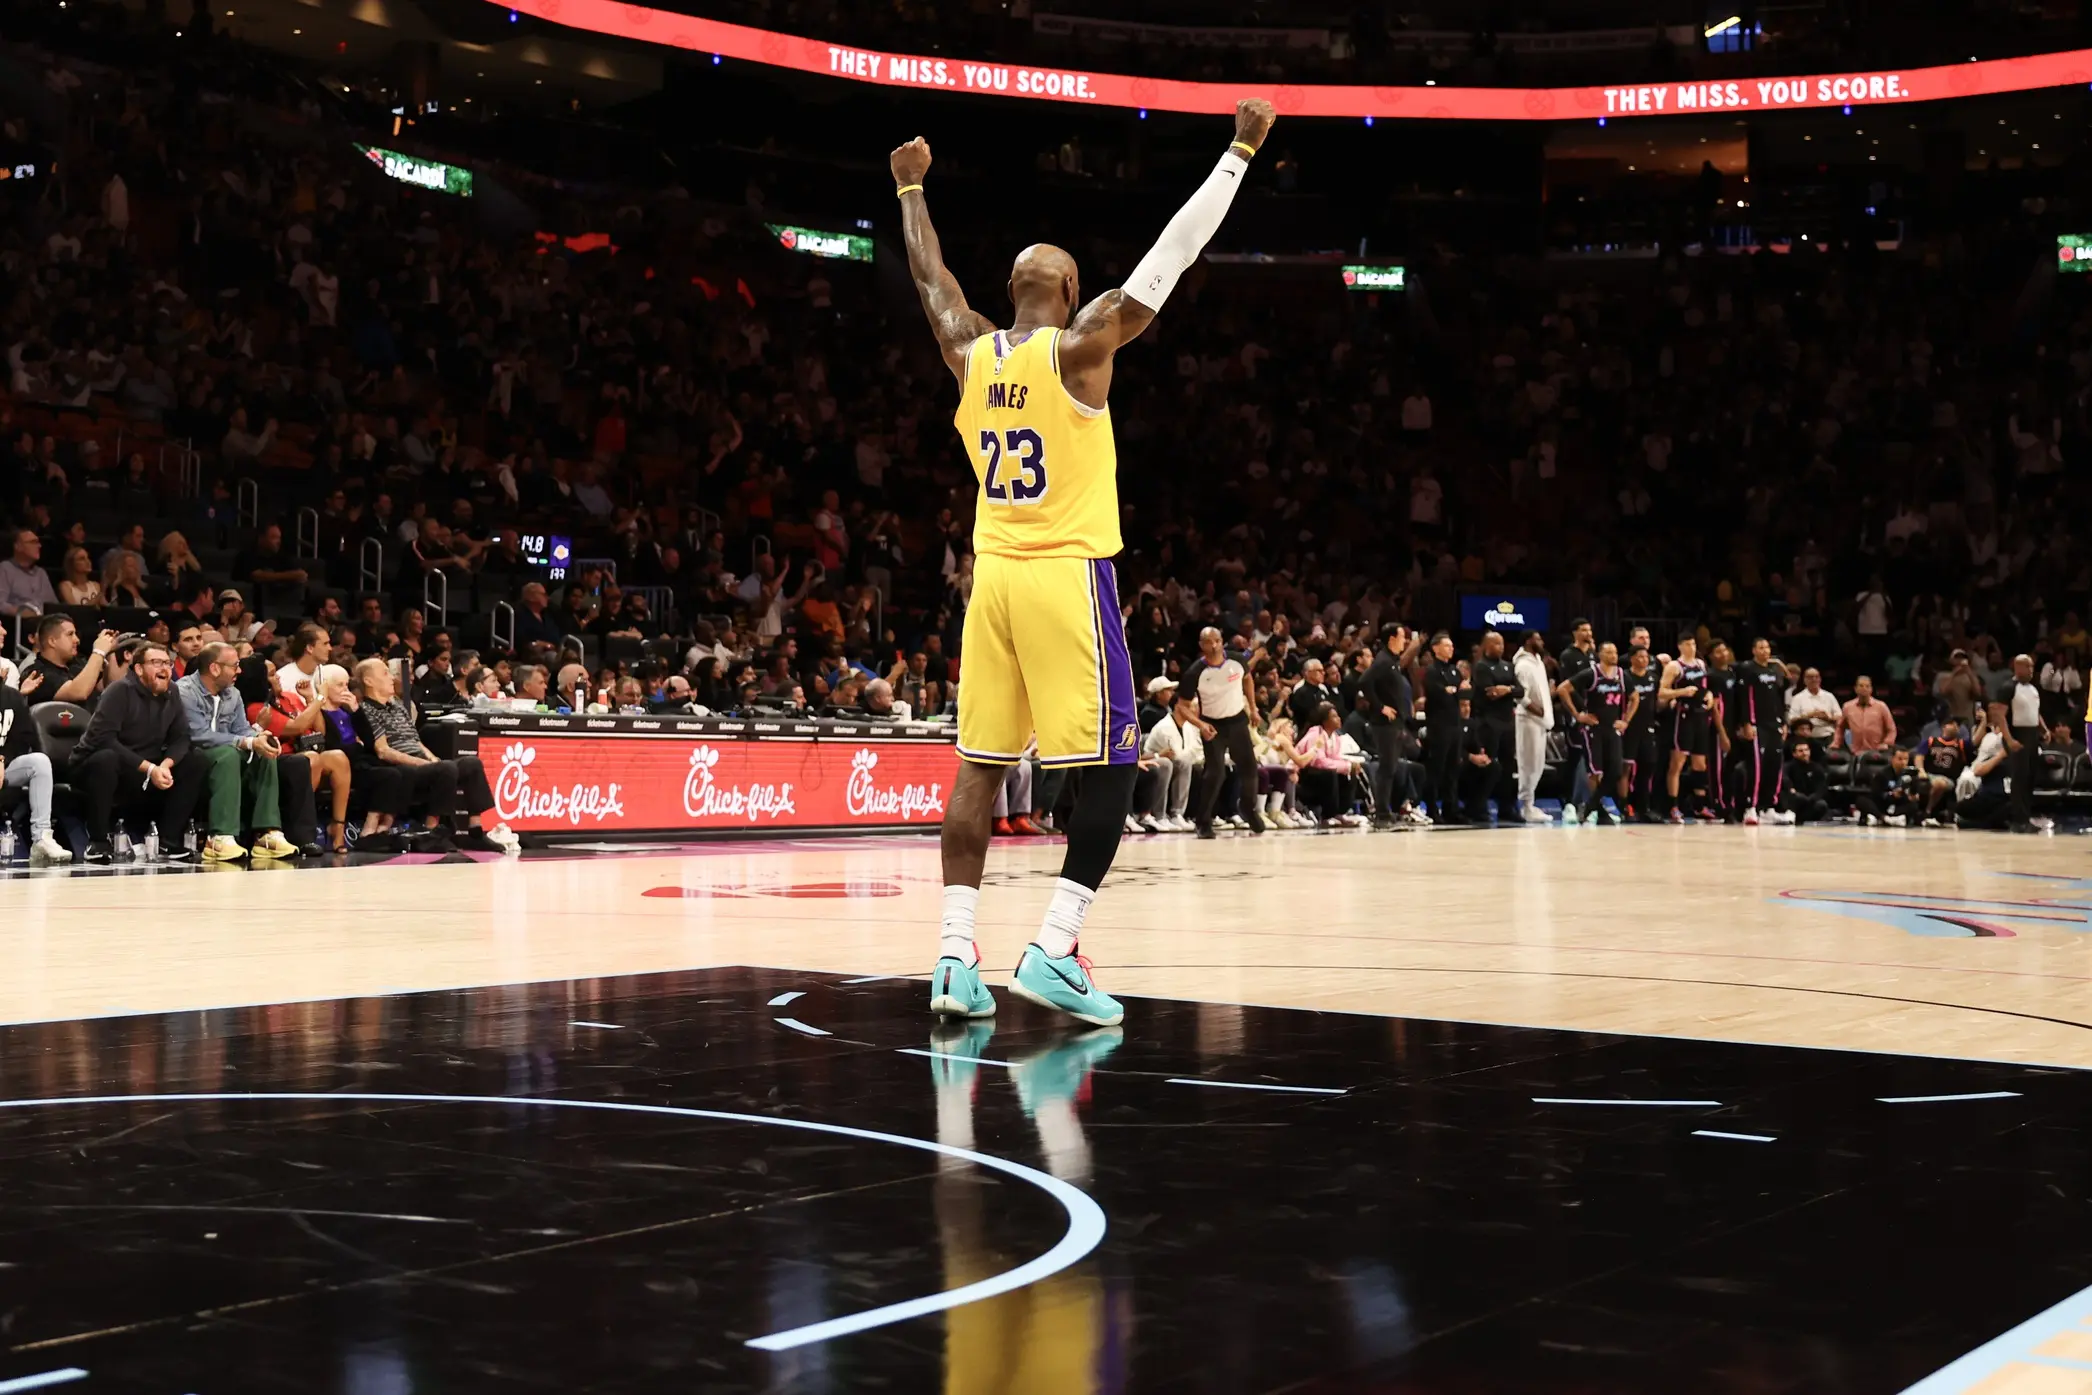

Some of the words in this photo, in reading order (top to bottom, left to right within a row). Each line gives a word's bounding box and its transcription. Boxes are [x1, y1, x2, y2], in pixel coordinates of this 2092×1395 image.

[828, 47, 881, 78] THEY
[889, 57, 956, 86] MISS.
[962, 64, 1009, 90] YOU
[1016, 70, 1097, 99] SCORE.
[1603, 87, 1668, 112] THEY
[1677, 83, 1749, 109] MISS.
[1756, 80, 1808, 104] YOU
[1817, 75, 1909, 102] SCORE.
[984, 383, 1028, 411] AMES
[980, 427, 1049, 506] 23
